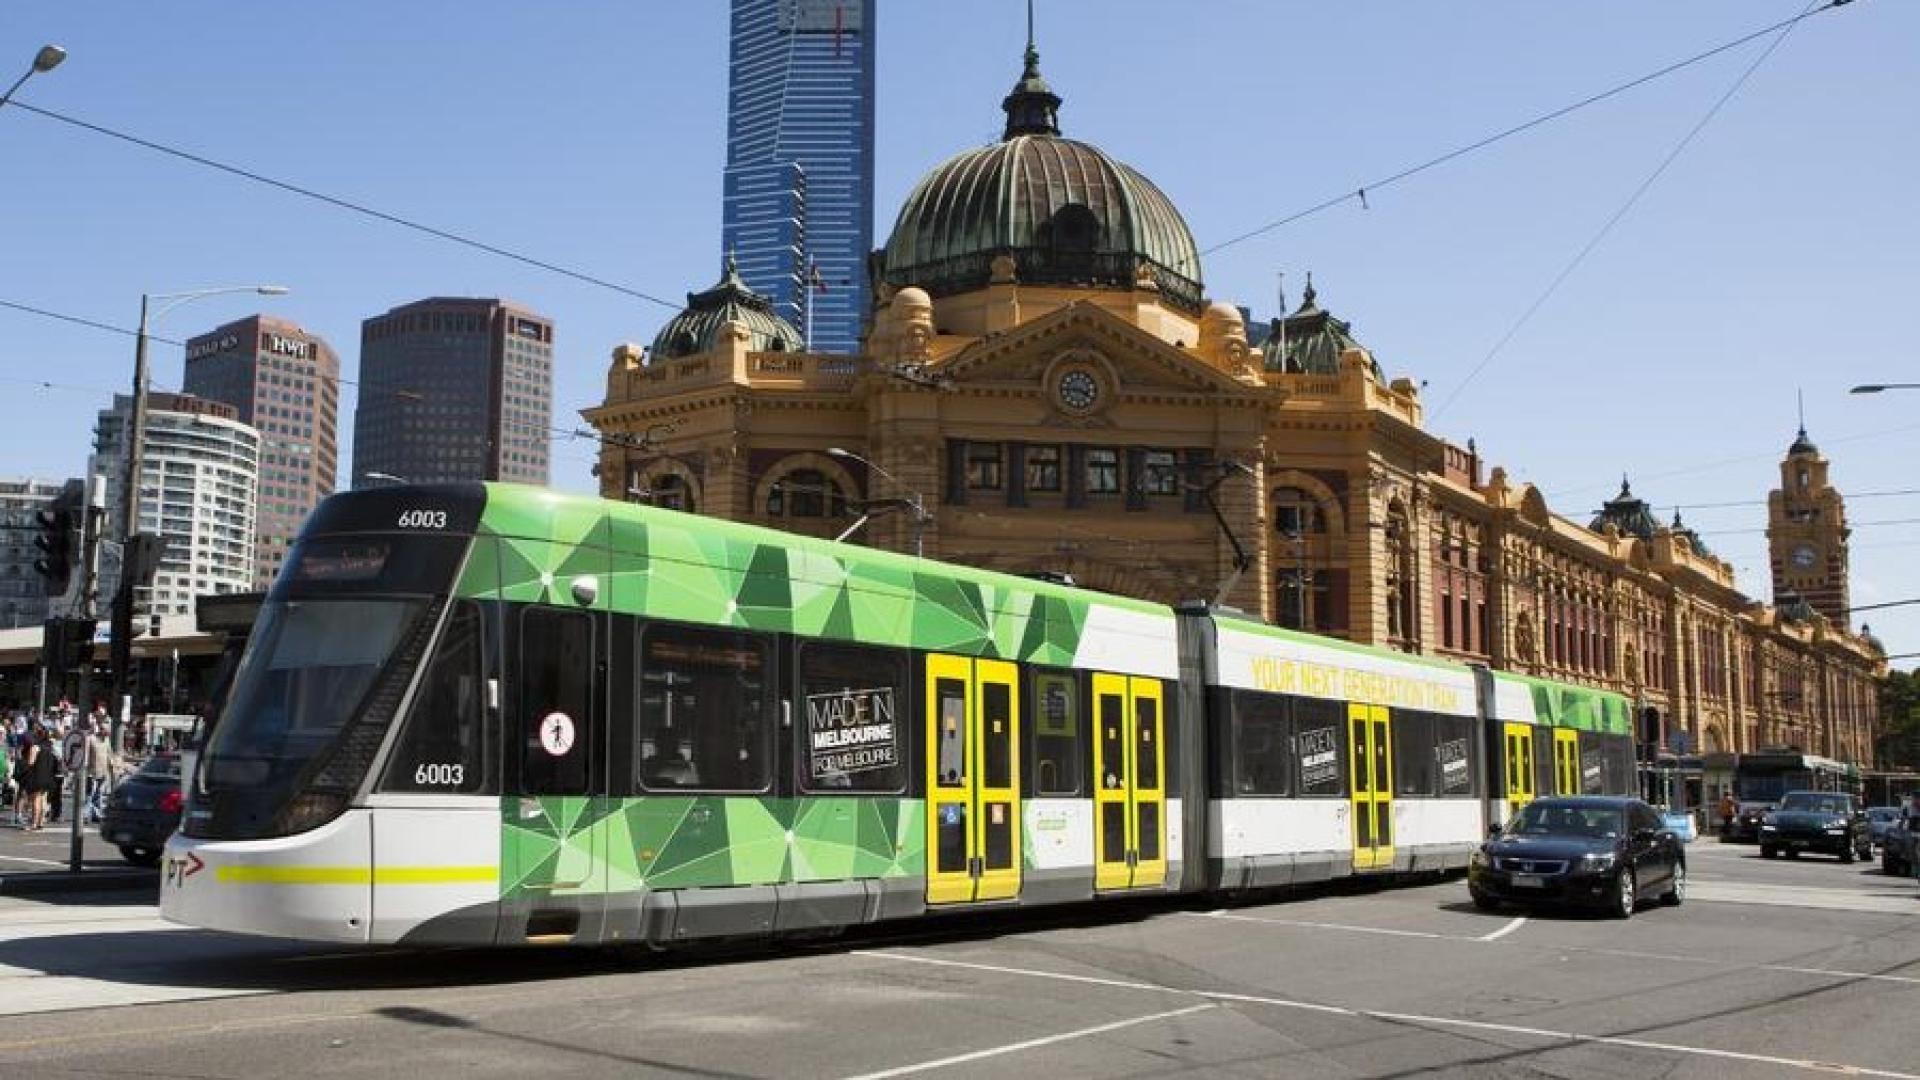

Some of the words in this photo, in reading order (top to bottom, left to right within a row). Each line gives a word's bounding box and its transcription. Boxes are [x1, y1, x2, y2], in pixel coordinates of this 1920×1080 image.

[398, 509, 447, 528] 6003
[1251, 655, 1296, 691] YOUR
[1301, 661, 1340, 697] NEXT
[811, 696, 870, 728] MADE
[873, 694, 891, 722] IN
[814, 723, 893, 748] MELBOURNE
[414, 763, 464, 785] 6003
